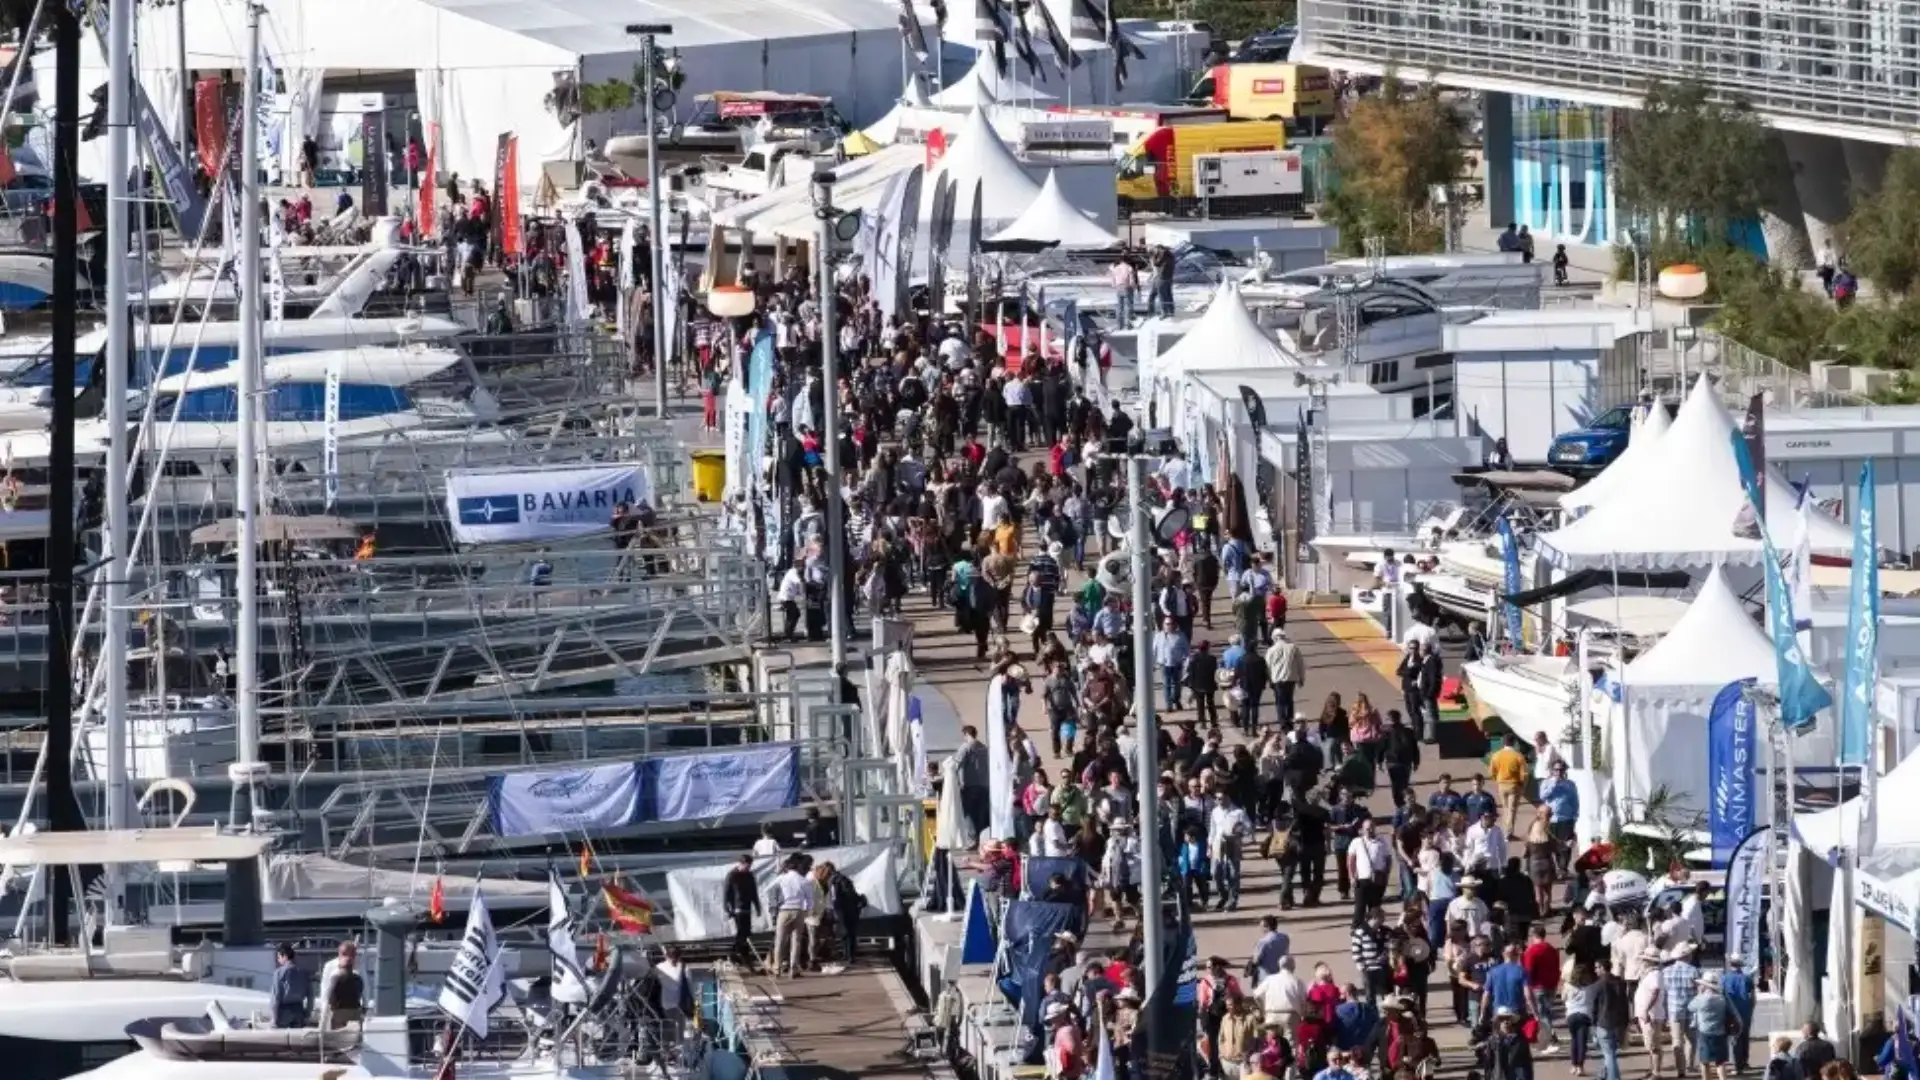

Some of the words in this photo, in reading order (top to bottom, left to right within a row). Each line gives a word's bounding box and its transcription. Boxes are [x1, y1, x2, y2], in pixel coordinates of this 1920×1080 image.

[1785, 440, 1832, 448] CAFETERIA
[524, 488, 635, 512] BAVARIA
[1732, 700, 1748, 843] ANMASTER
